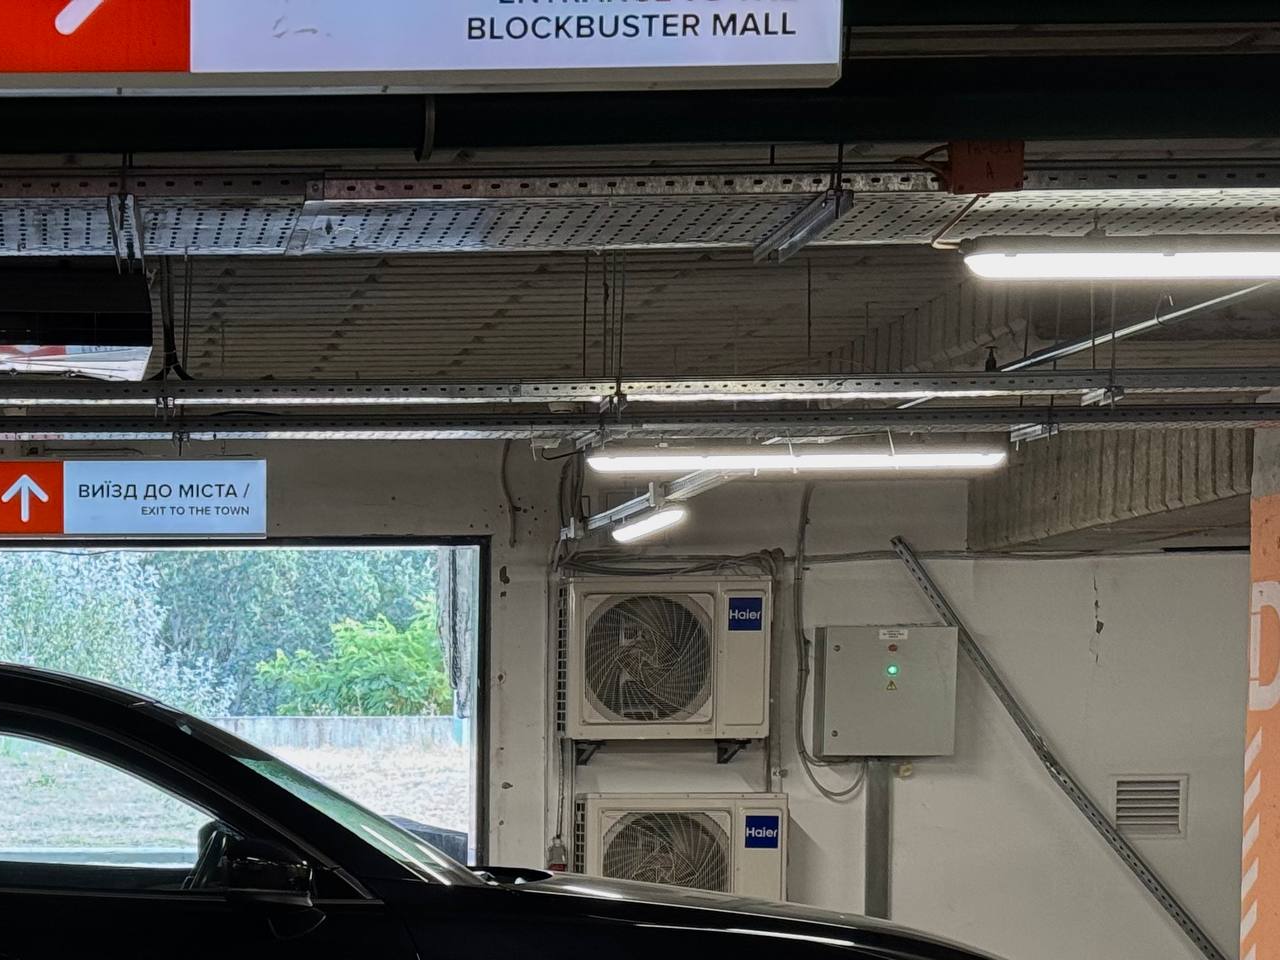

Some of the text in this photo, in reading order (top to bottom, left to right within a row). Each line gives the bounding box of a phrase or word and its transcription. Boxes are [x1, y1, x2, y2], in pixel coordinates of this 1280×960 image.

[467, 12, 797, 40] BLOCKBUSTER MALL
[78, 480, 138, 500] ВИЇЗД
[143, 483, 172, 501] ДО
[178, 483, 238, 498] МІСТА
[141, 506, 250, 515] EXIT TO THE TOWN
[729, 608, 761, 622] Haier
[746, 826, 779, 839] Haier
